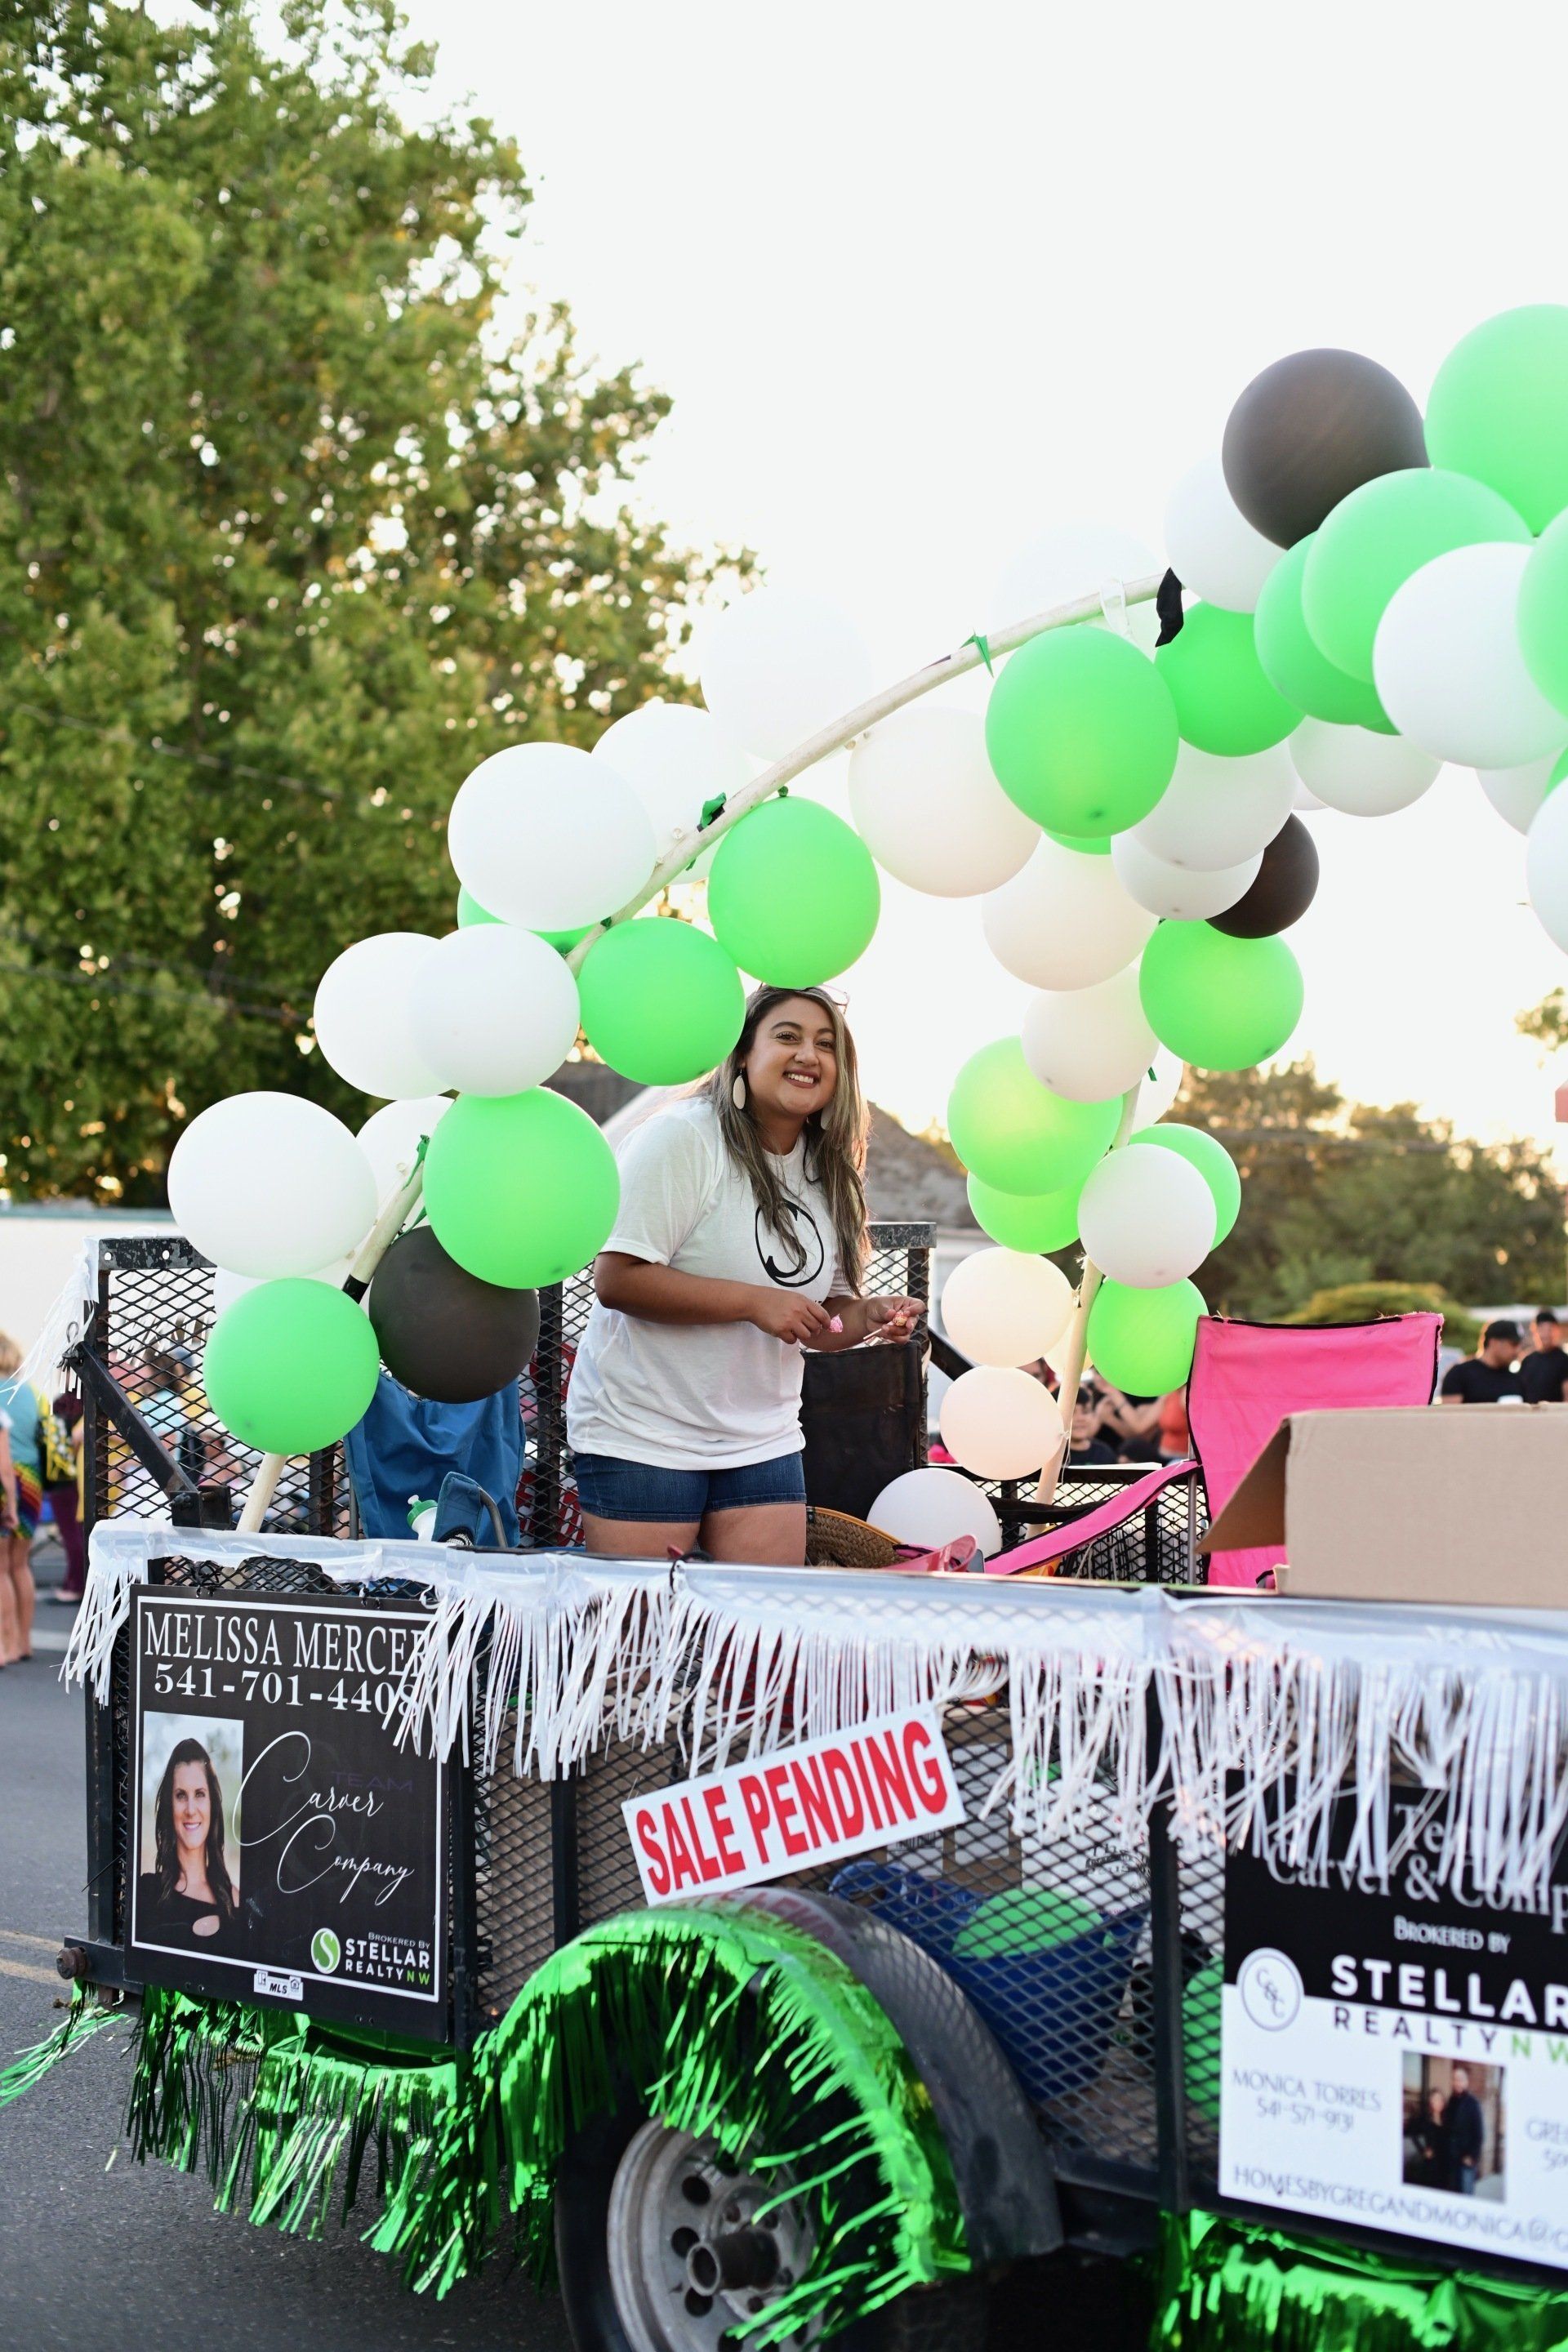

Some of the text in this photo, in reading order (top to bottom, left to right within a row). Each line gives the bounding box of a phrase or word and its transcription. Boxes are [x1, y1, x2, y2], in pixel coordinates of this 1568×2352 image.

[144, 1611, 430, 1677] MELISSA MERCER
[154, 1663, 421, 1716] 541-701-4408
[232, 1731, 384, 1846] Carver
[635, 1720, 948, 1896] SALE PENDING
[277, 1814, 415, 1906] Company
[1405, 1854, 1440, 1903] &
[345, 1938, 430, 1969] STELLAR
[368, 1931, 430, 1949] BROKERED BY
[1394, 1914, 1512, 1954] BROKERED BY
[270, 1983, 287, 1994] MLS
[1330, 1953, 1568, 2028] STELLAR
[1232, 2069, 1382, 2112] MONICA TORRES
